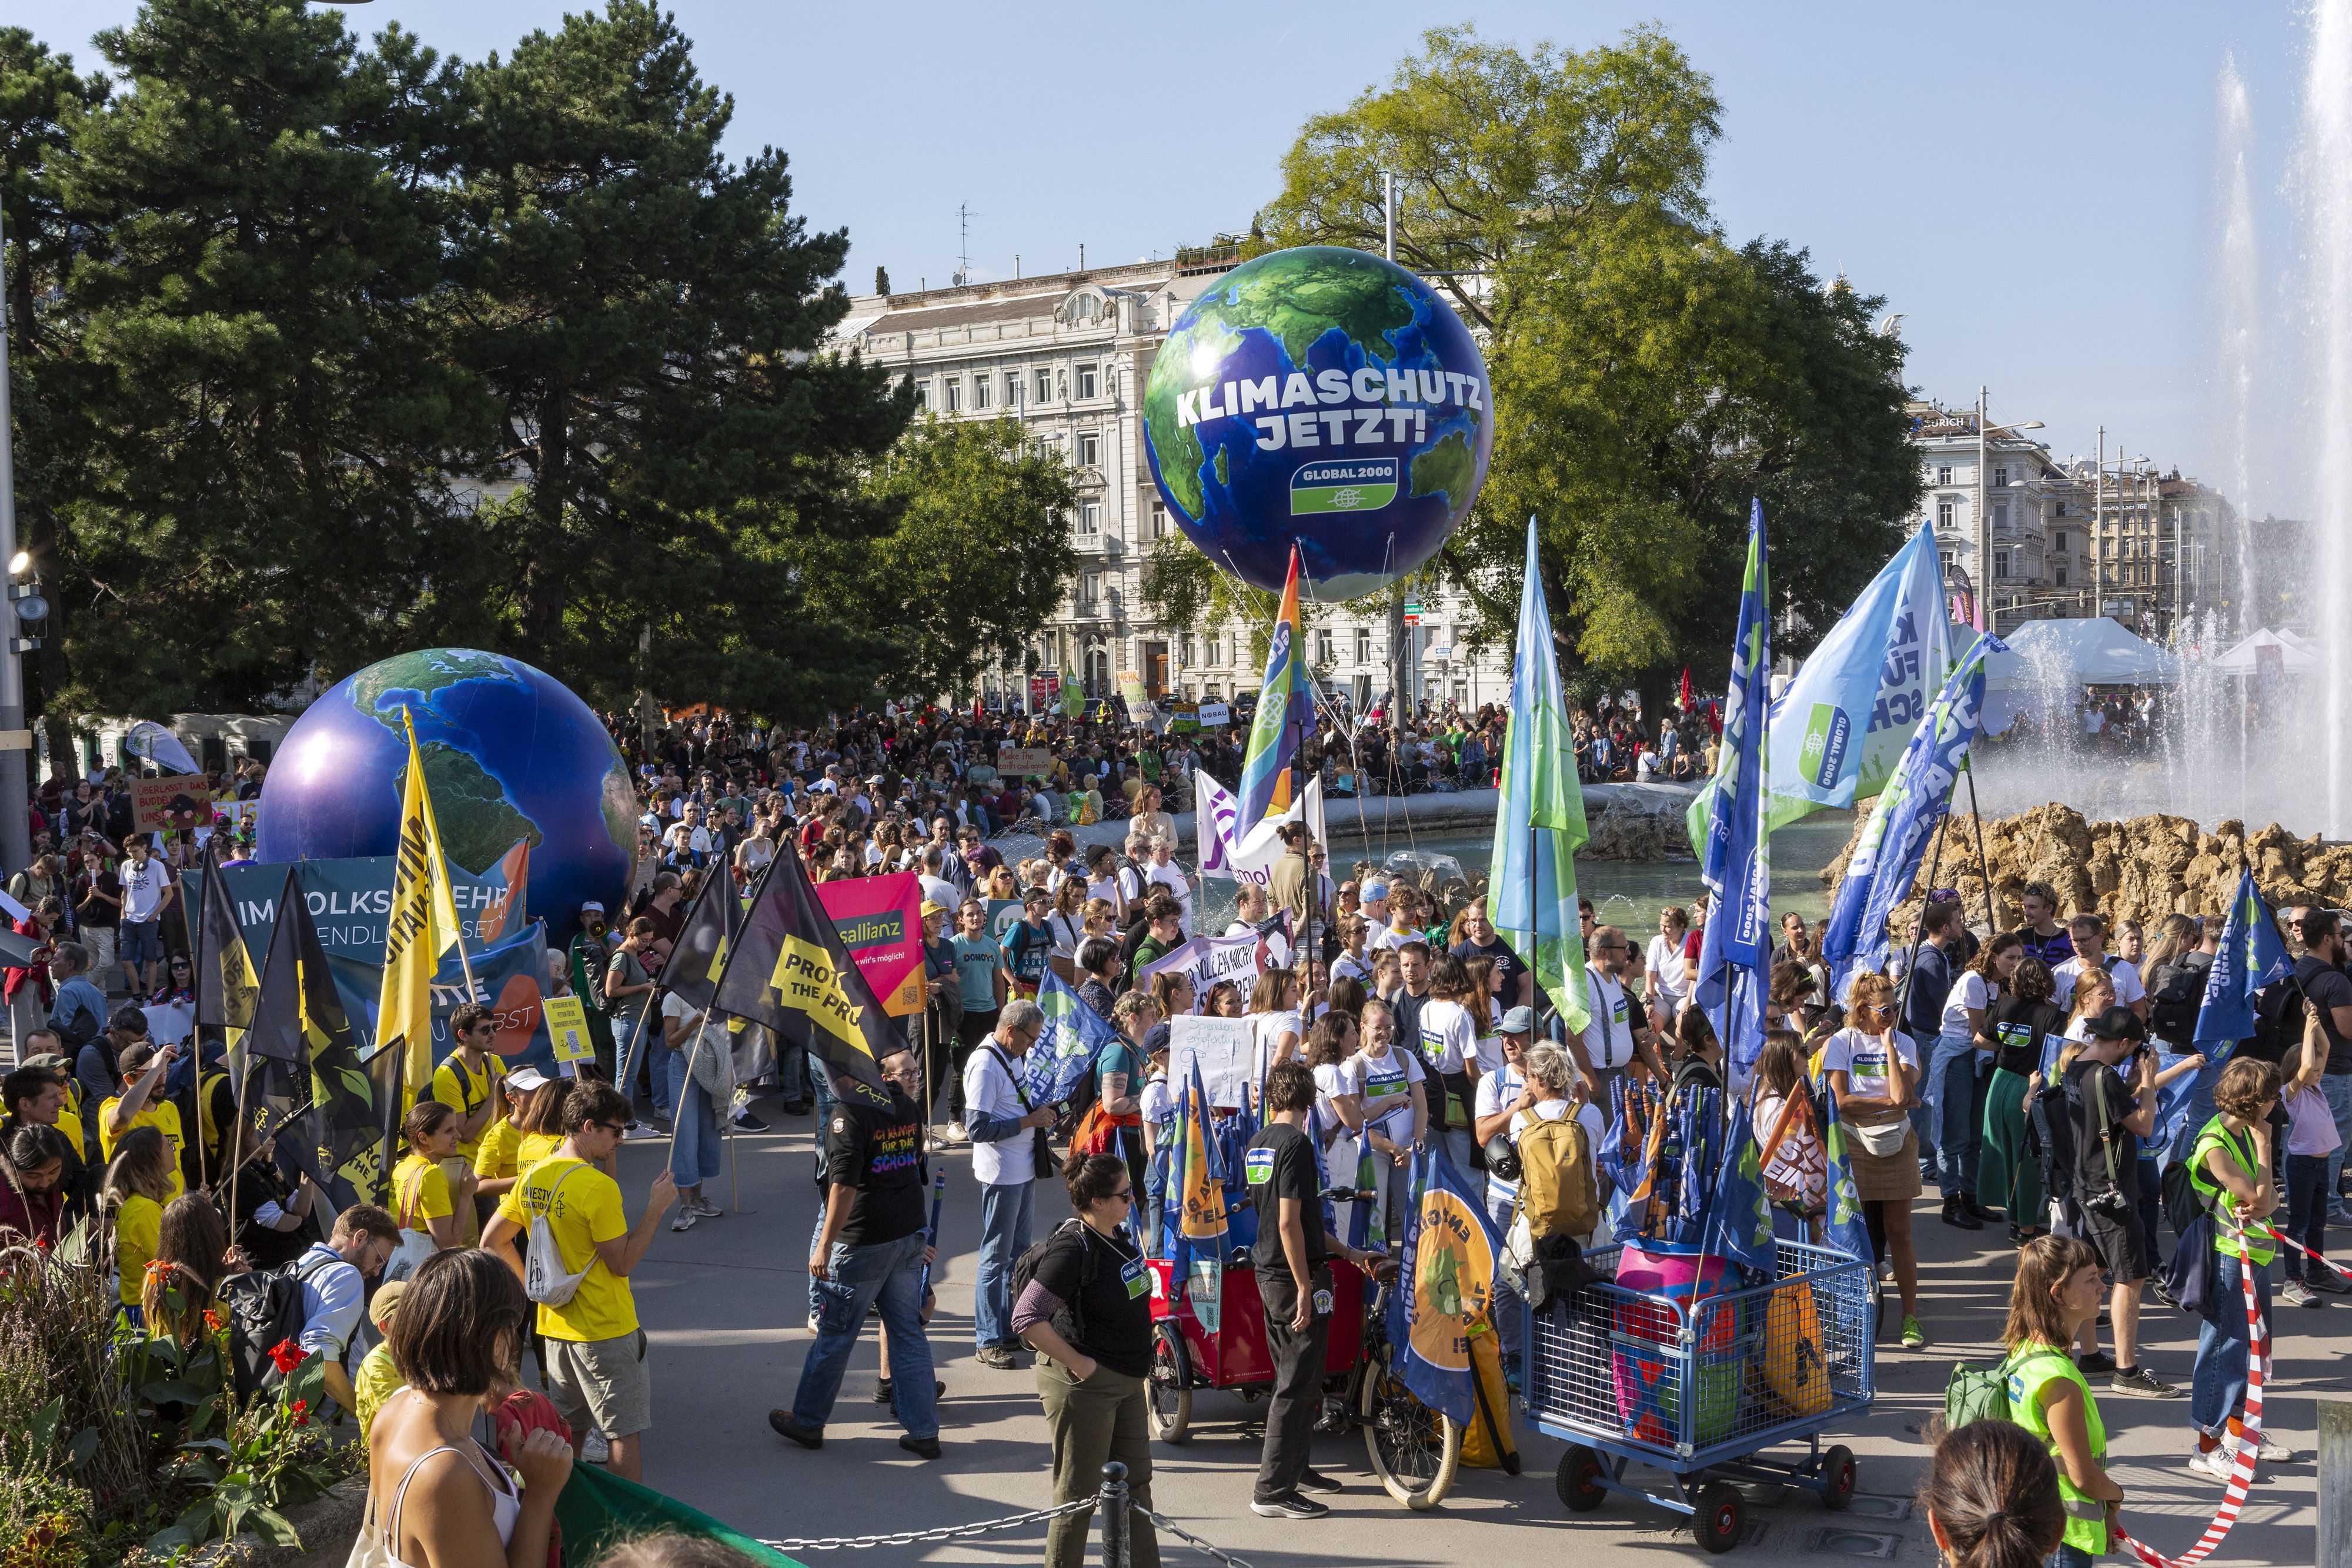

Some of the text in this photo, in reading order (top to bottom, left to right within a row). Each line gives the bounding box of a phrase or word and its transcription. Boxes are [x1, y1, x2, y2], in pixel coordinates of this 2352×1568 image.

[1177, 369, 1482, 428] KLIMASCHUTZ
[1255, 409, 1425, 450] JETZT!
[1303, 466, 1392, 481] GLOBAL 2000
[1118, 671, 1140, 683] MEHR
[999, 750, 1021, 761] Make
[1823, 717, 1846, 786] GLOBAL 2000
[999, 761, 1049, 773] earth cool again
[138, 781, 206, 795] ÜBERLASST DAS
[139, 795, 175, 807] BUDDELN
[239, 899, 274, 926] IM
[839, 921, 900, 944] sallianz
[860, 951, 905, 966] wir's möglich!
[963, 952, 995, 963] DONOTS
[1230, 942, 1257, 971] NICHT
[2220, 942, 2230, 987] SIND
[2210, 959, 2221, 998] UND
[791, 982, 820, 999] THE
[882, 1137, 914, 1154] FÜR DAS
[348, 1156, 370, 1180] THE
[518, 1160, 539, 1169] MNESTY
[871, 1151, 917, 1174] SCHÖN
[522, 1186, 552, 1201] AMNESTY
